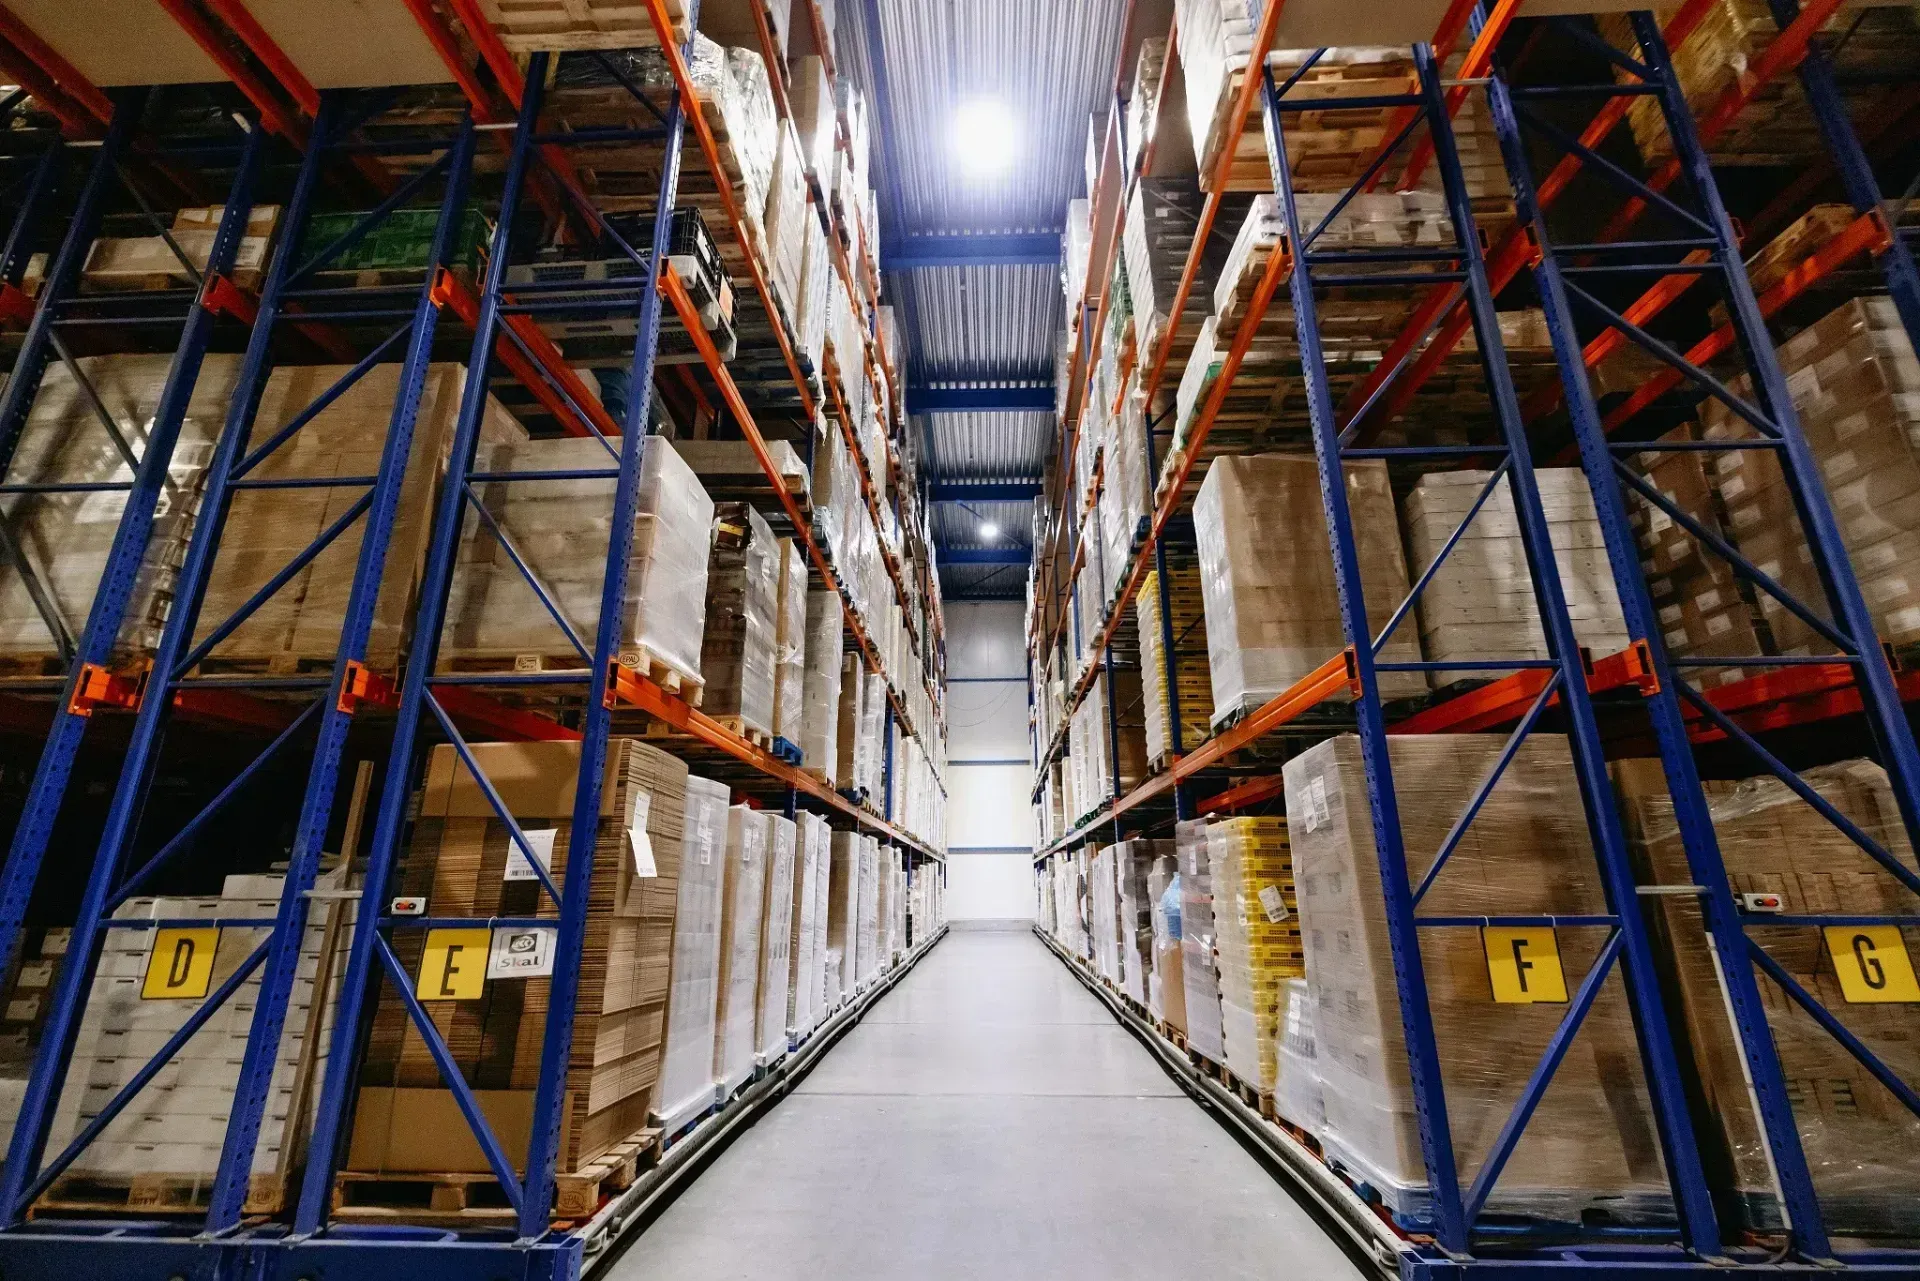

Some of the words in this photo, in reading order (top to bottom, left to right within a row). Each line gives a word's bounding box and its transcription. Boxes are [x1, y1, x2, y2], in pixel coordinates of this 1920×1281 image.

[621, 654, 637, 663] EPAL
[167, 938, 195, 988] D
[440, 945, 463, 996] E
[1511, 939, 1533, 992] F
[1852, 934, 1885, 989] G
